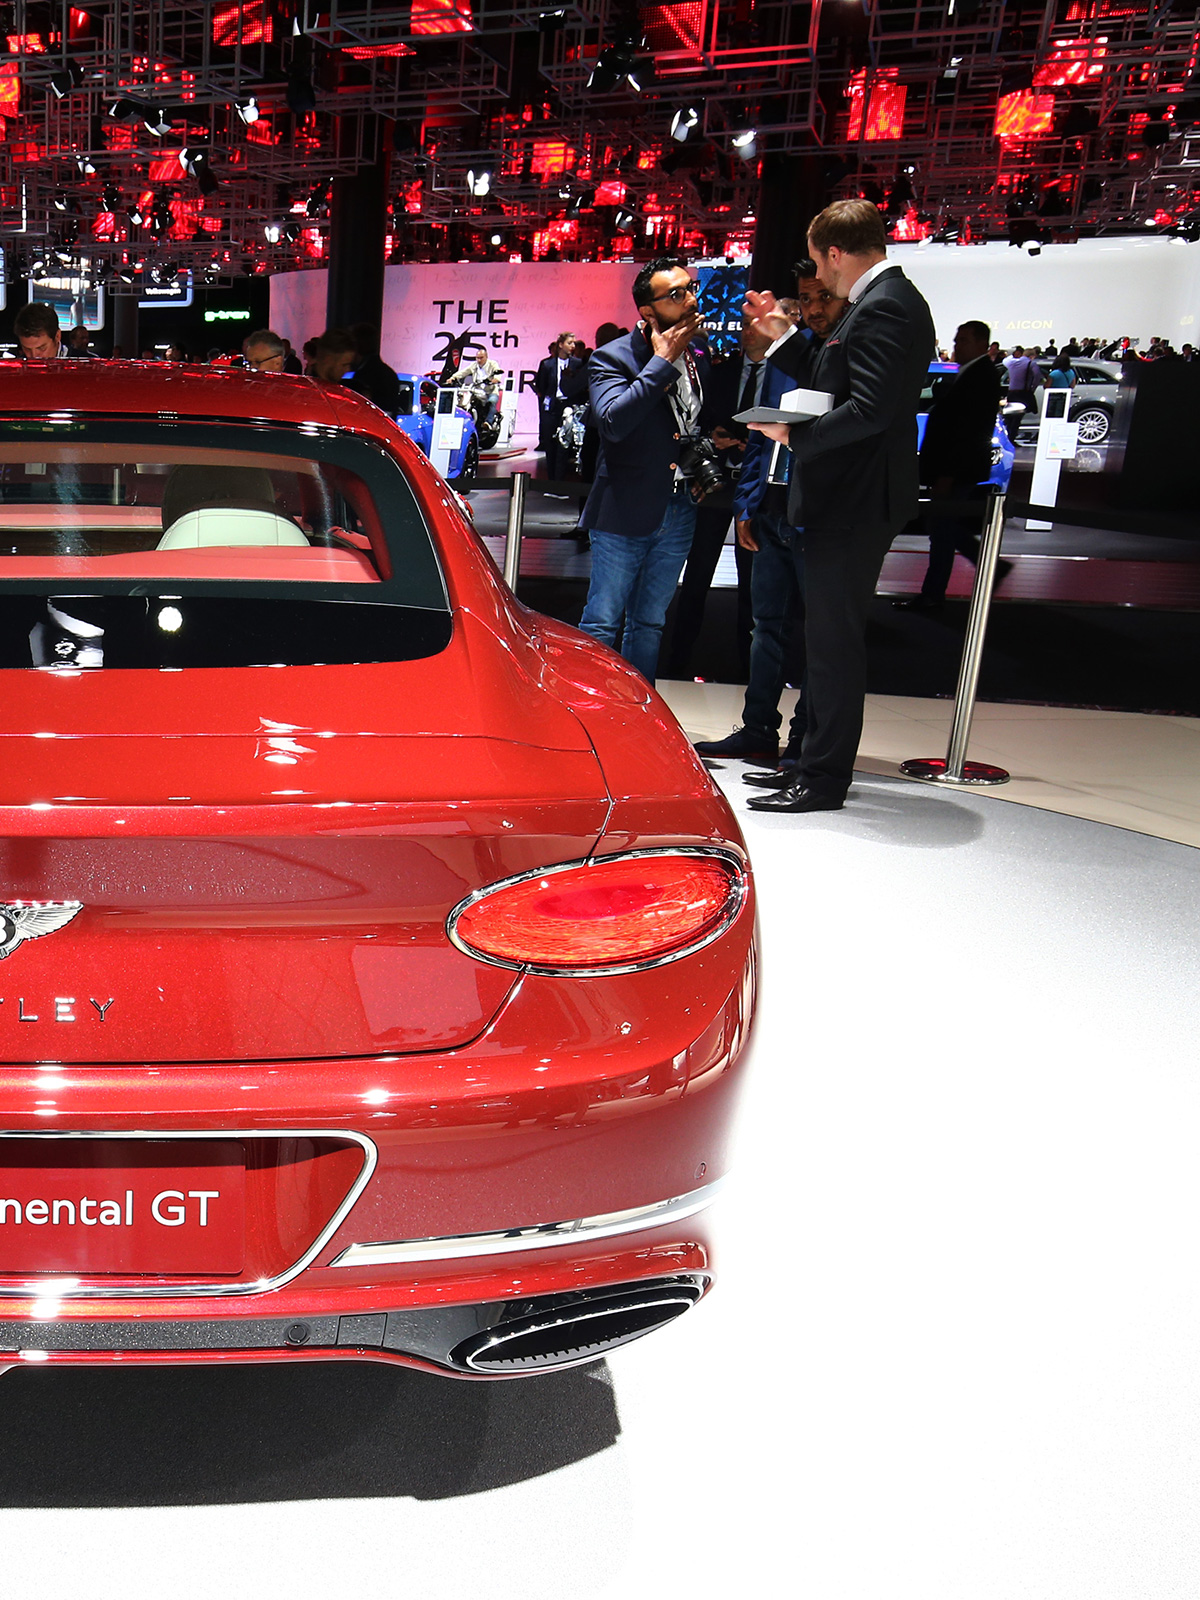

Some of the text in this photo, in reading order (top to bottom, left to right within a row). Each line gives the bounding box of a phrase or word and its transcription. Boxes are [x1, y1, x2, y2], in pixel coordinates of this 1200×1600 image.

[433, 299, 509, 324] THE
[1005, 319, 1053, 330] AICON
[151, 1190, 220, 1227] GT
